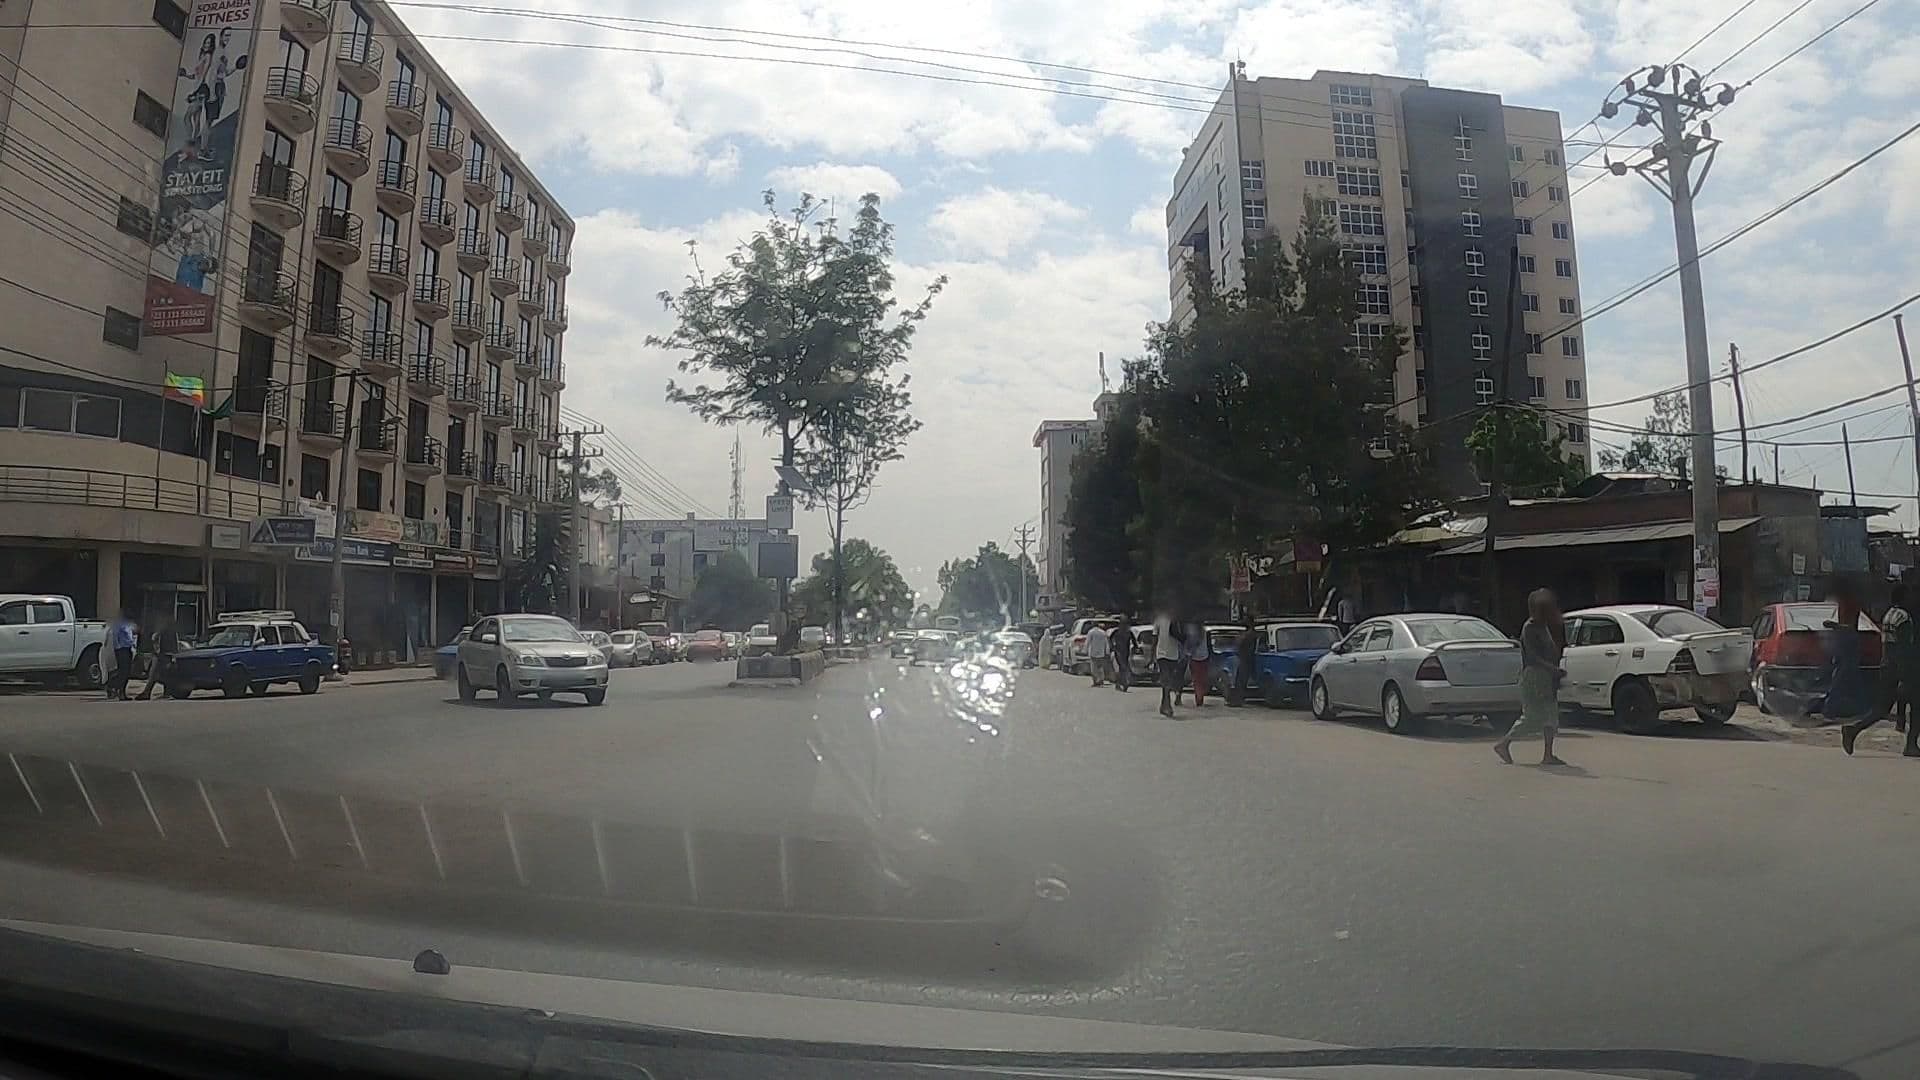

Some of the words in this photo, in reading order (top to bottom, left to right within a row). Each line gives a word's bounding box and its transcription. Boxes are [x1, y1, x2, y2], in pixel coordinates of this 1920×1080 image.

[195, 9, 249, 26] FITNESS
[166, 172, 199, 187] STAY
[202, 169, 224, 184] FIT
